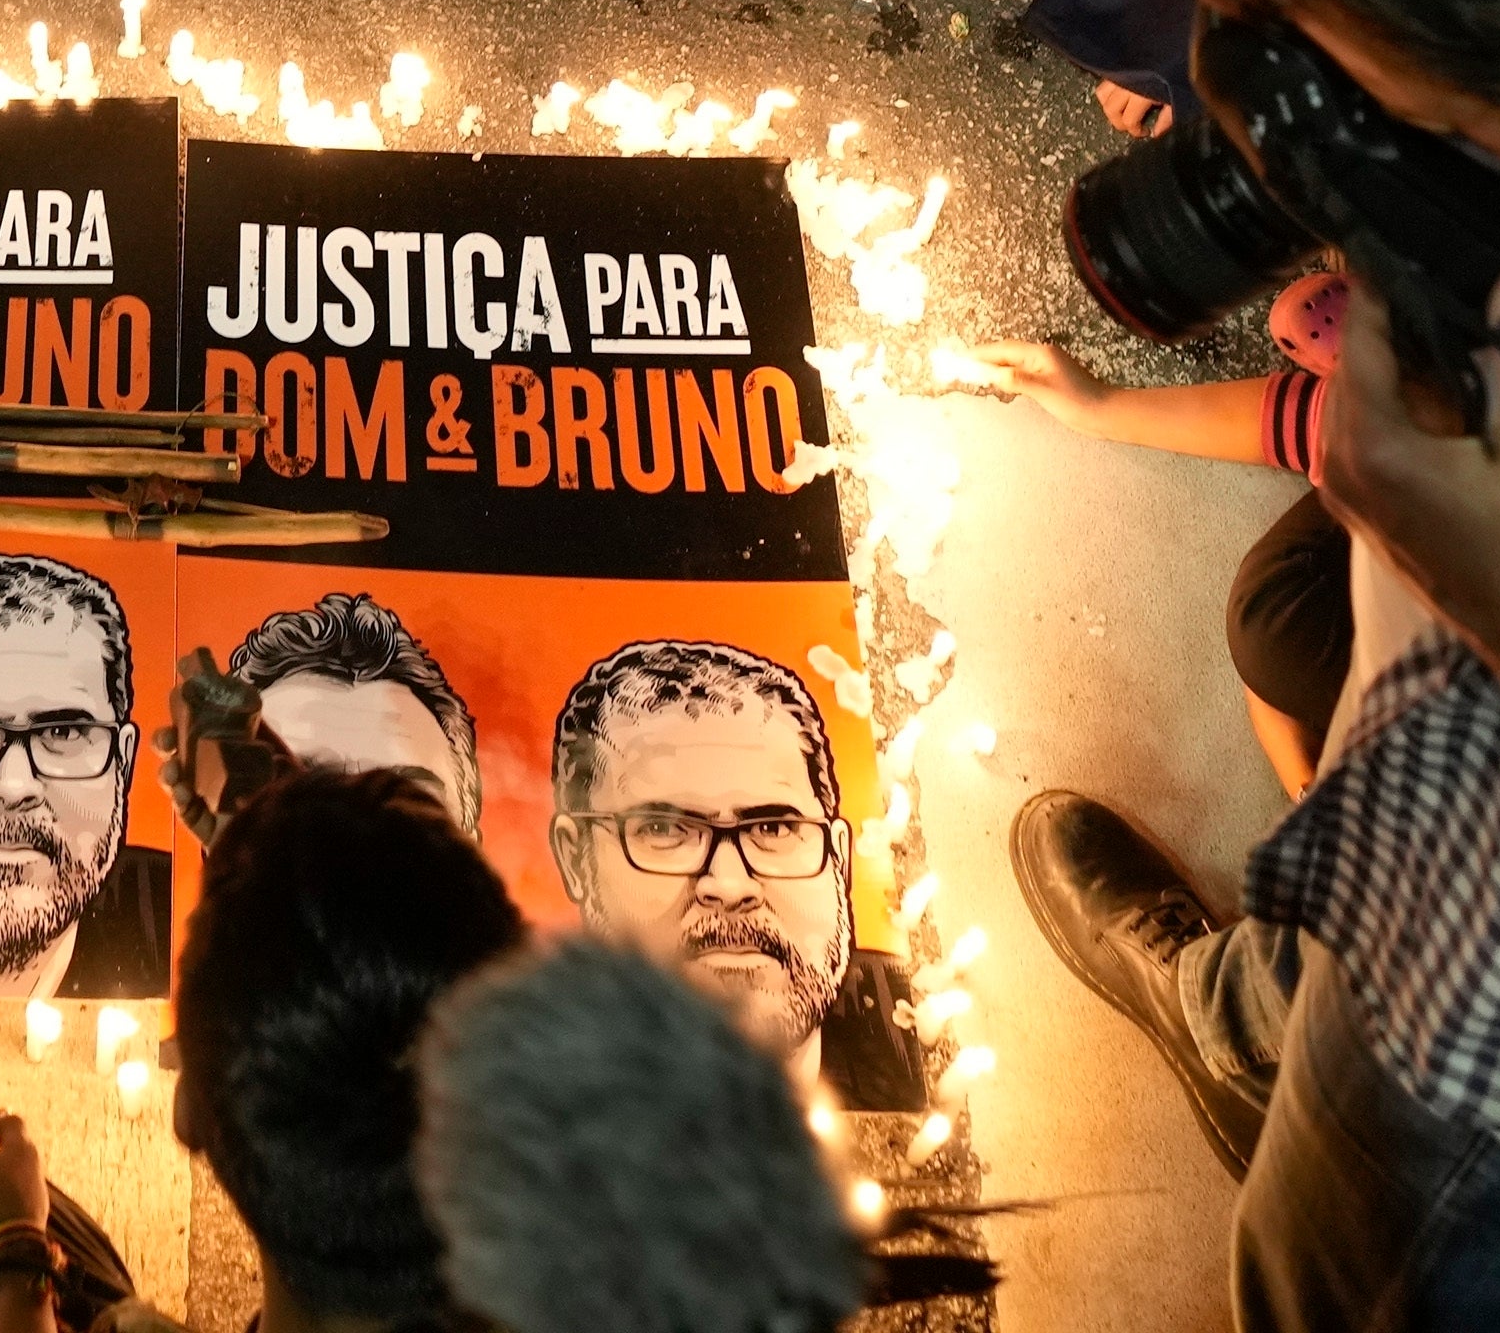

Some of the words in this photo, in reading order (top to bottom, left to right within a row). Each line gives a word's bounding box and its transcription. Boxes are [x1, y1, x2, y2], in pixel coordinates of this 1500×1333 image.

[207, 222, 571, 360] JUSTIÇA
[585, 253, 748, 337] PARA
[204, 348, 407, 483] DOM
[425, 373, 475, 453] &
[494, 363, 804, 496] BRUNO
